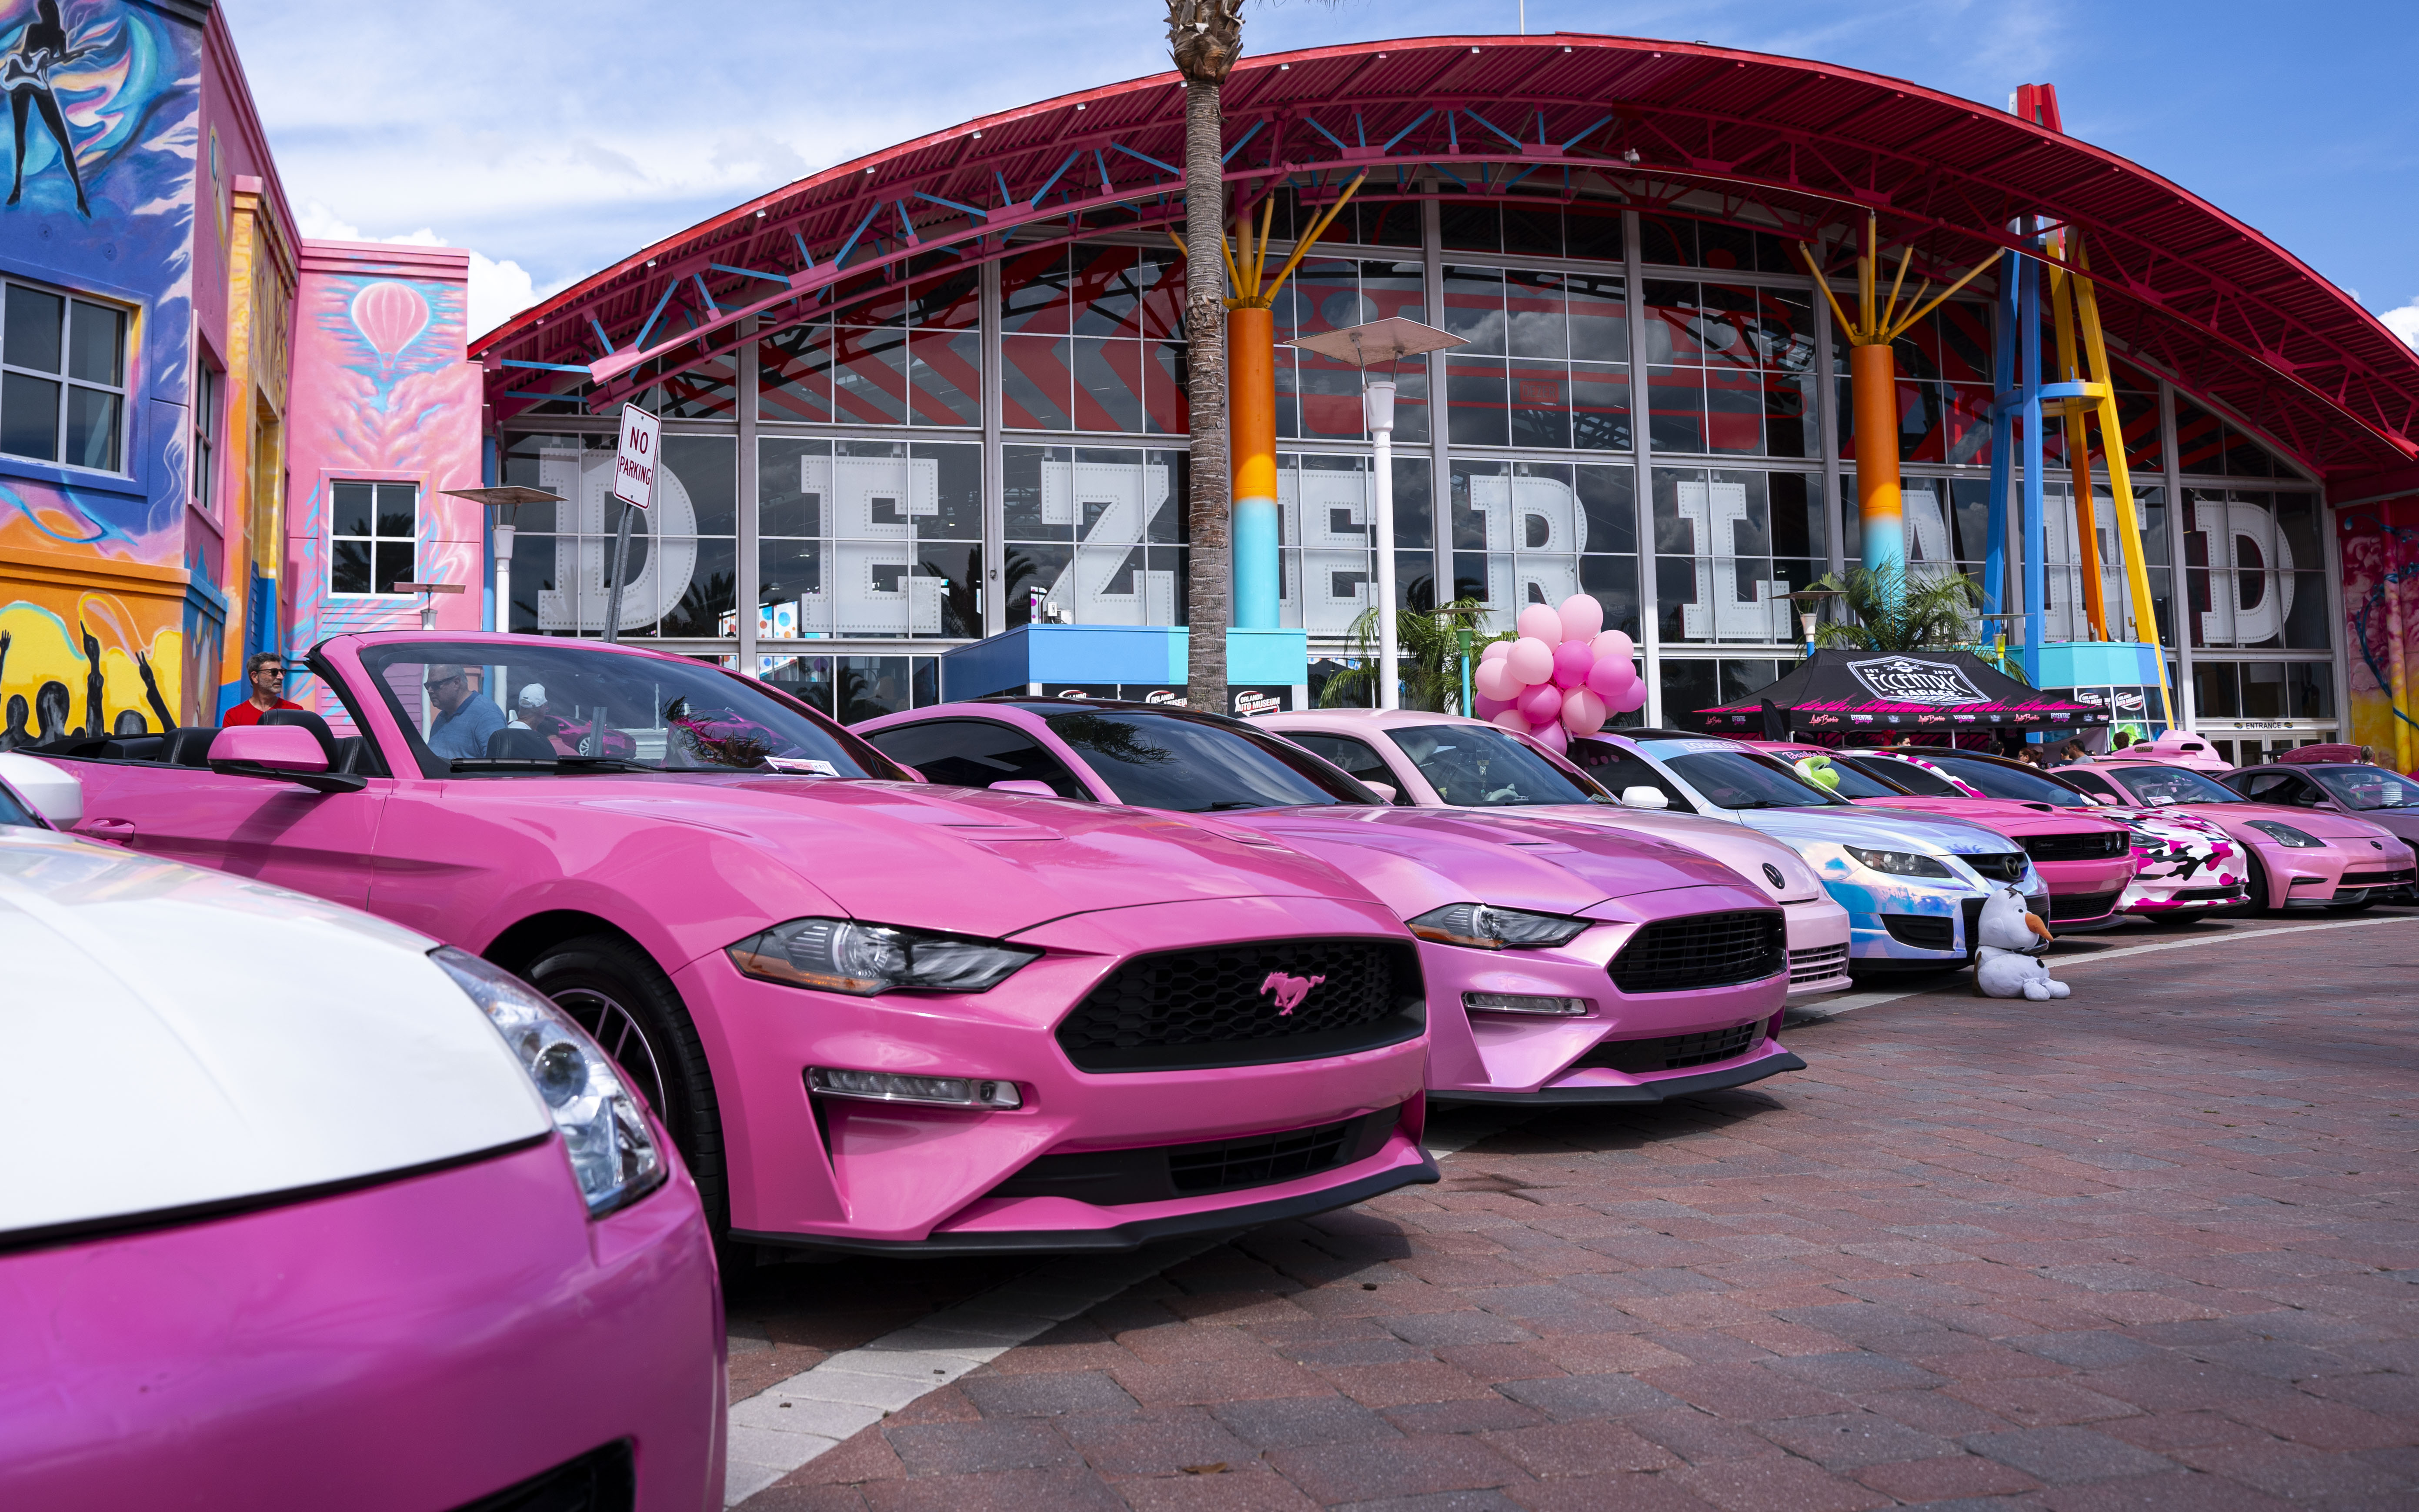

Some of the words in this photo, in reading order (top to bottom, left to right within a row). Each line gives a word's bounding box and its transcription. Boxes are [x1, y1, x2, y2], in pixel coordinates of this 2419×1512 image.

[1523, 384, 1556, 398] DEZER
[629, 426, 649, 454] NO
[619, 455, 651, 485] PARKING
[1866, 673, 1972, 694] ECCENTRIC
[1151, 693, 1175, 703] ORLANDO
[1240, 693, 1263, 703] ORLANDO
[2126, 695, 2142, 704] MUSEUM
[1235, 702, 1251, 712] AUTO
[1252, 697, 1280, 709] MUSEUM
[1682, 742, 1745, 750] LOWGLOW
[1782, 751, 1818, 760] Barbie
